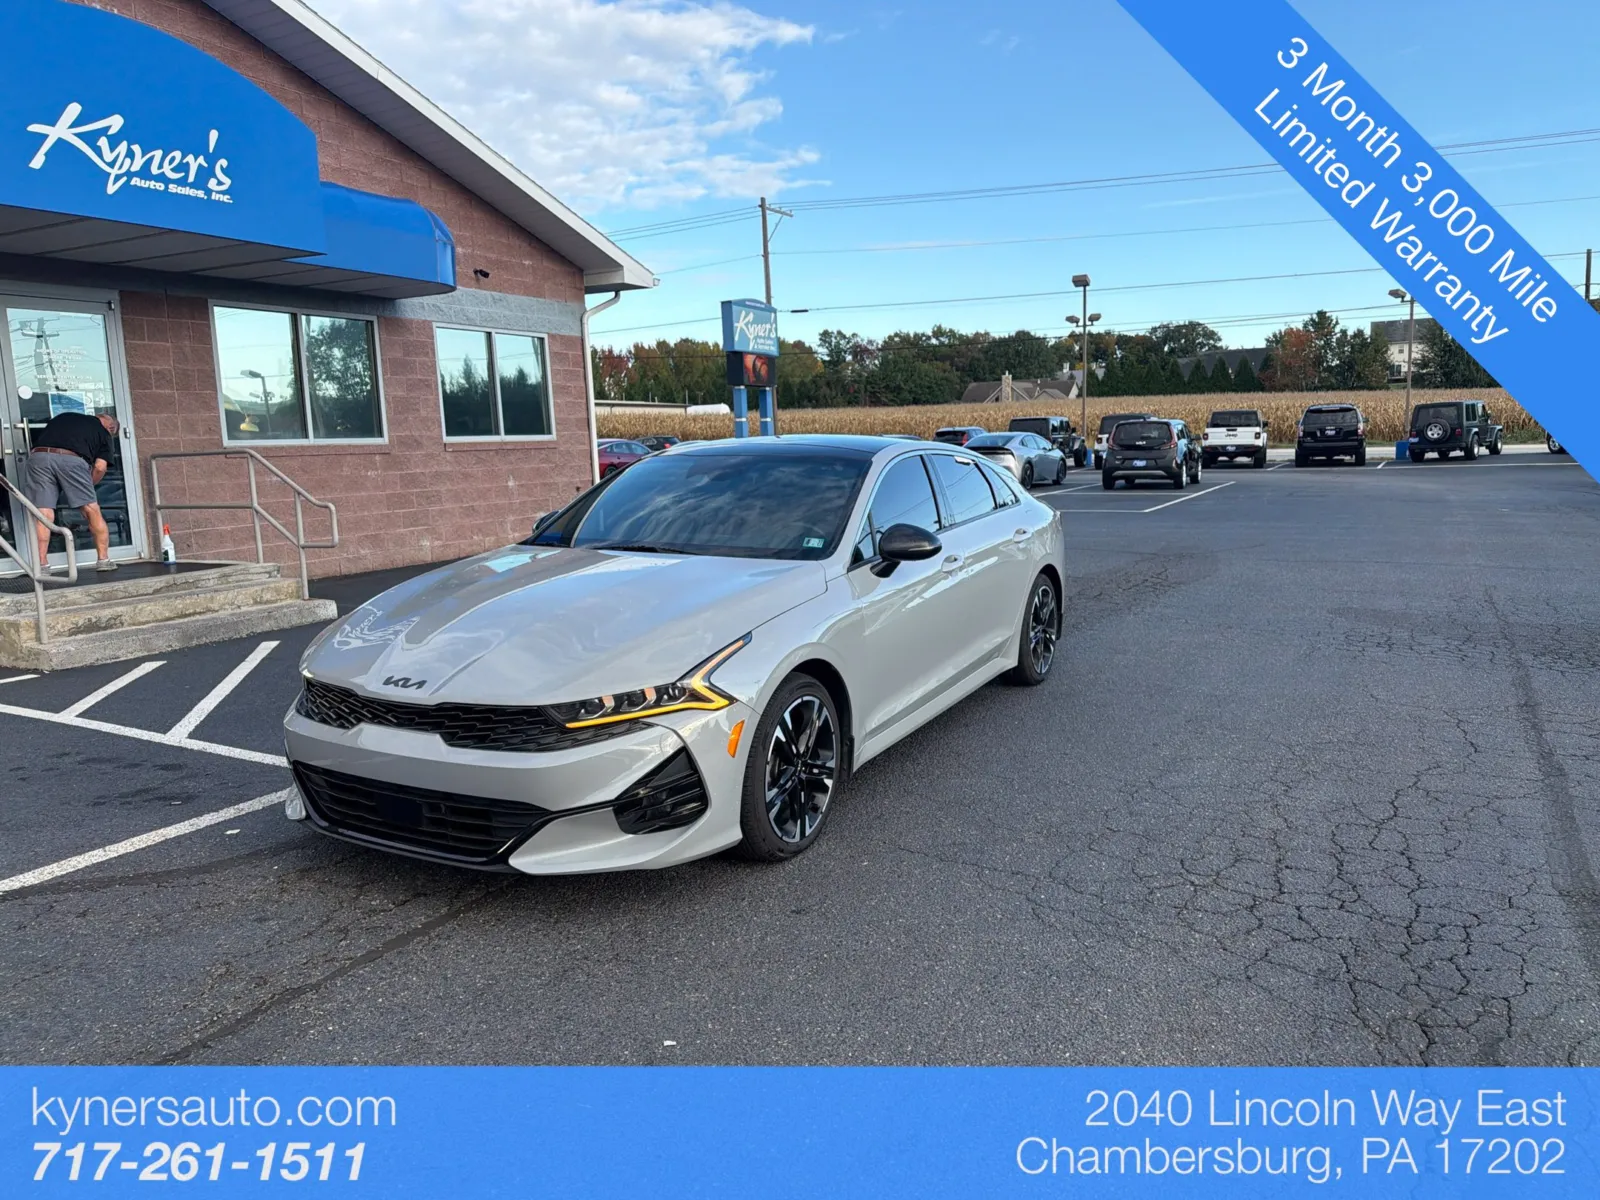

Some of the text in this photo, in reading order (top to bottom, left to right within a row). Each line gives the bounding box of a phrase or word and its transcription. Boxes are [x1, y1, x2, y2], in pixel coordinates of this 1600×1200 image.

[26, 101, 232, 195] Kyner's
[130, 176, 165, 191] Auto
[168, 183, 208, 200] Sales,
[734, 310, 776, 351] Kyner's
